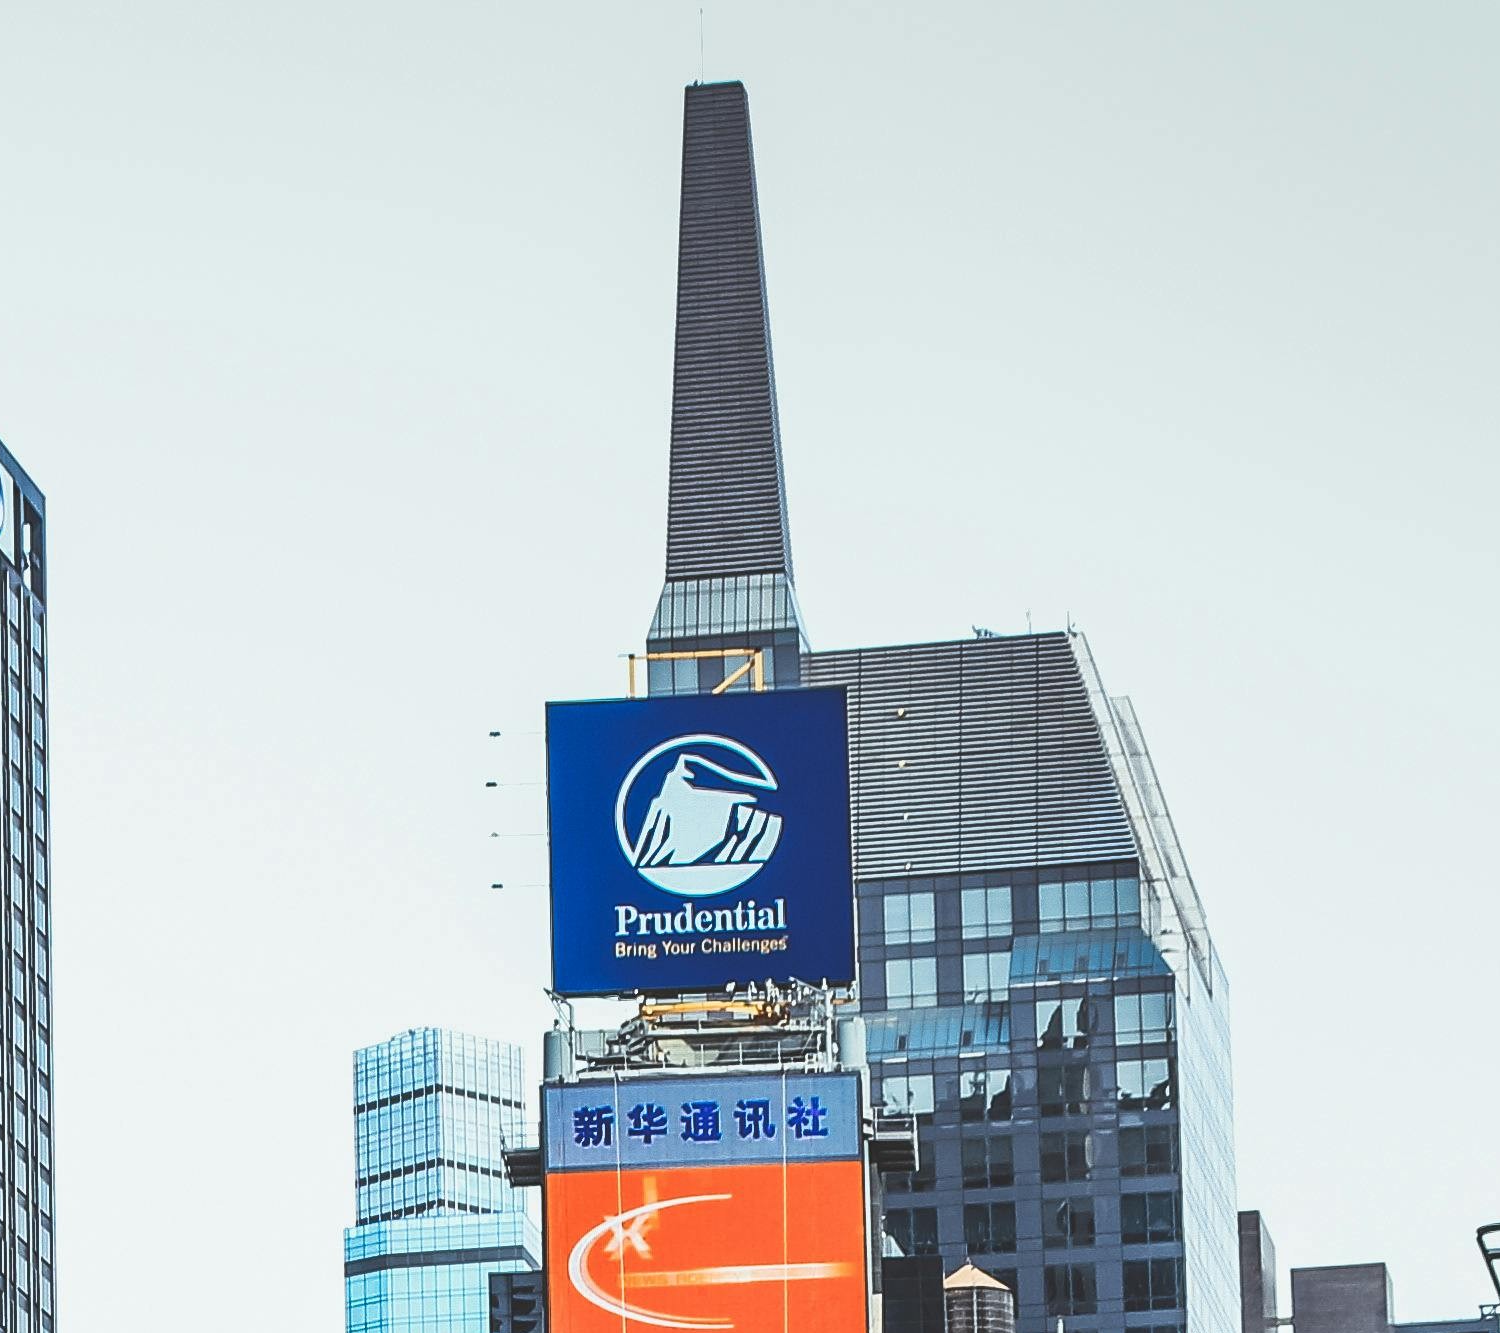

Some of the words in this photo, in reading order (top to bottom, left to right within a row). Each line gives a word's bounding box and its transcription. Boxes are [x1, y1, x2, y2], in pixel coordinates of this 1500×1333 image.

[615, 900, 787, 937] Prudential
[615, 941, 657, 958] Bring
[662, 940, 695, 955] Your
[701, 936, 788, 954] Challenges
[573, 1096, 829, 1147] 新华通讯社
